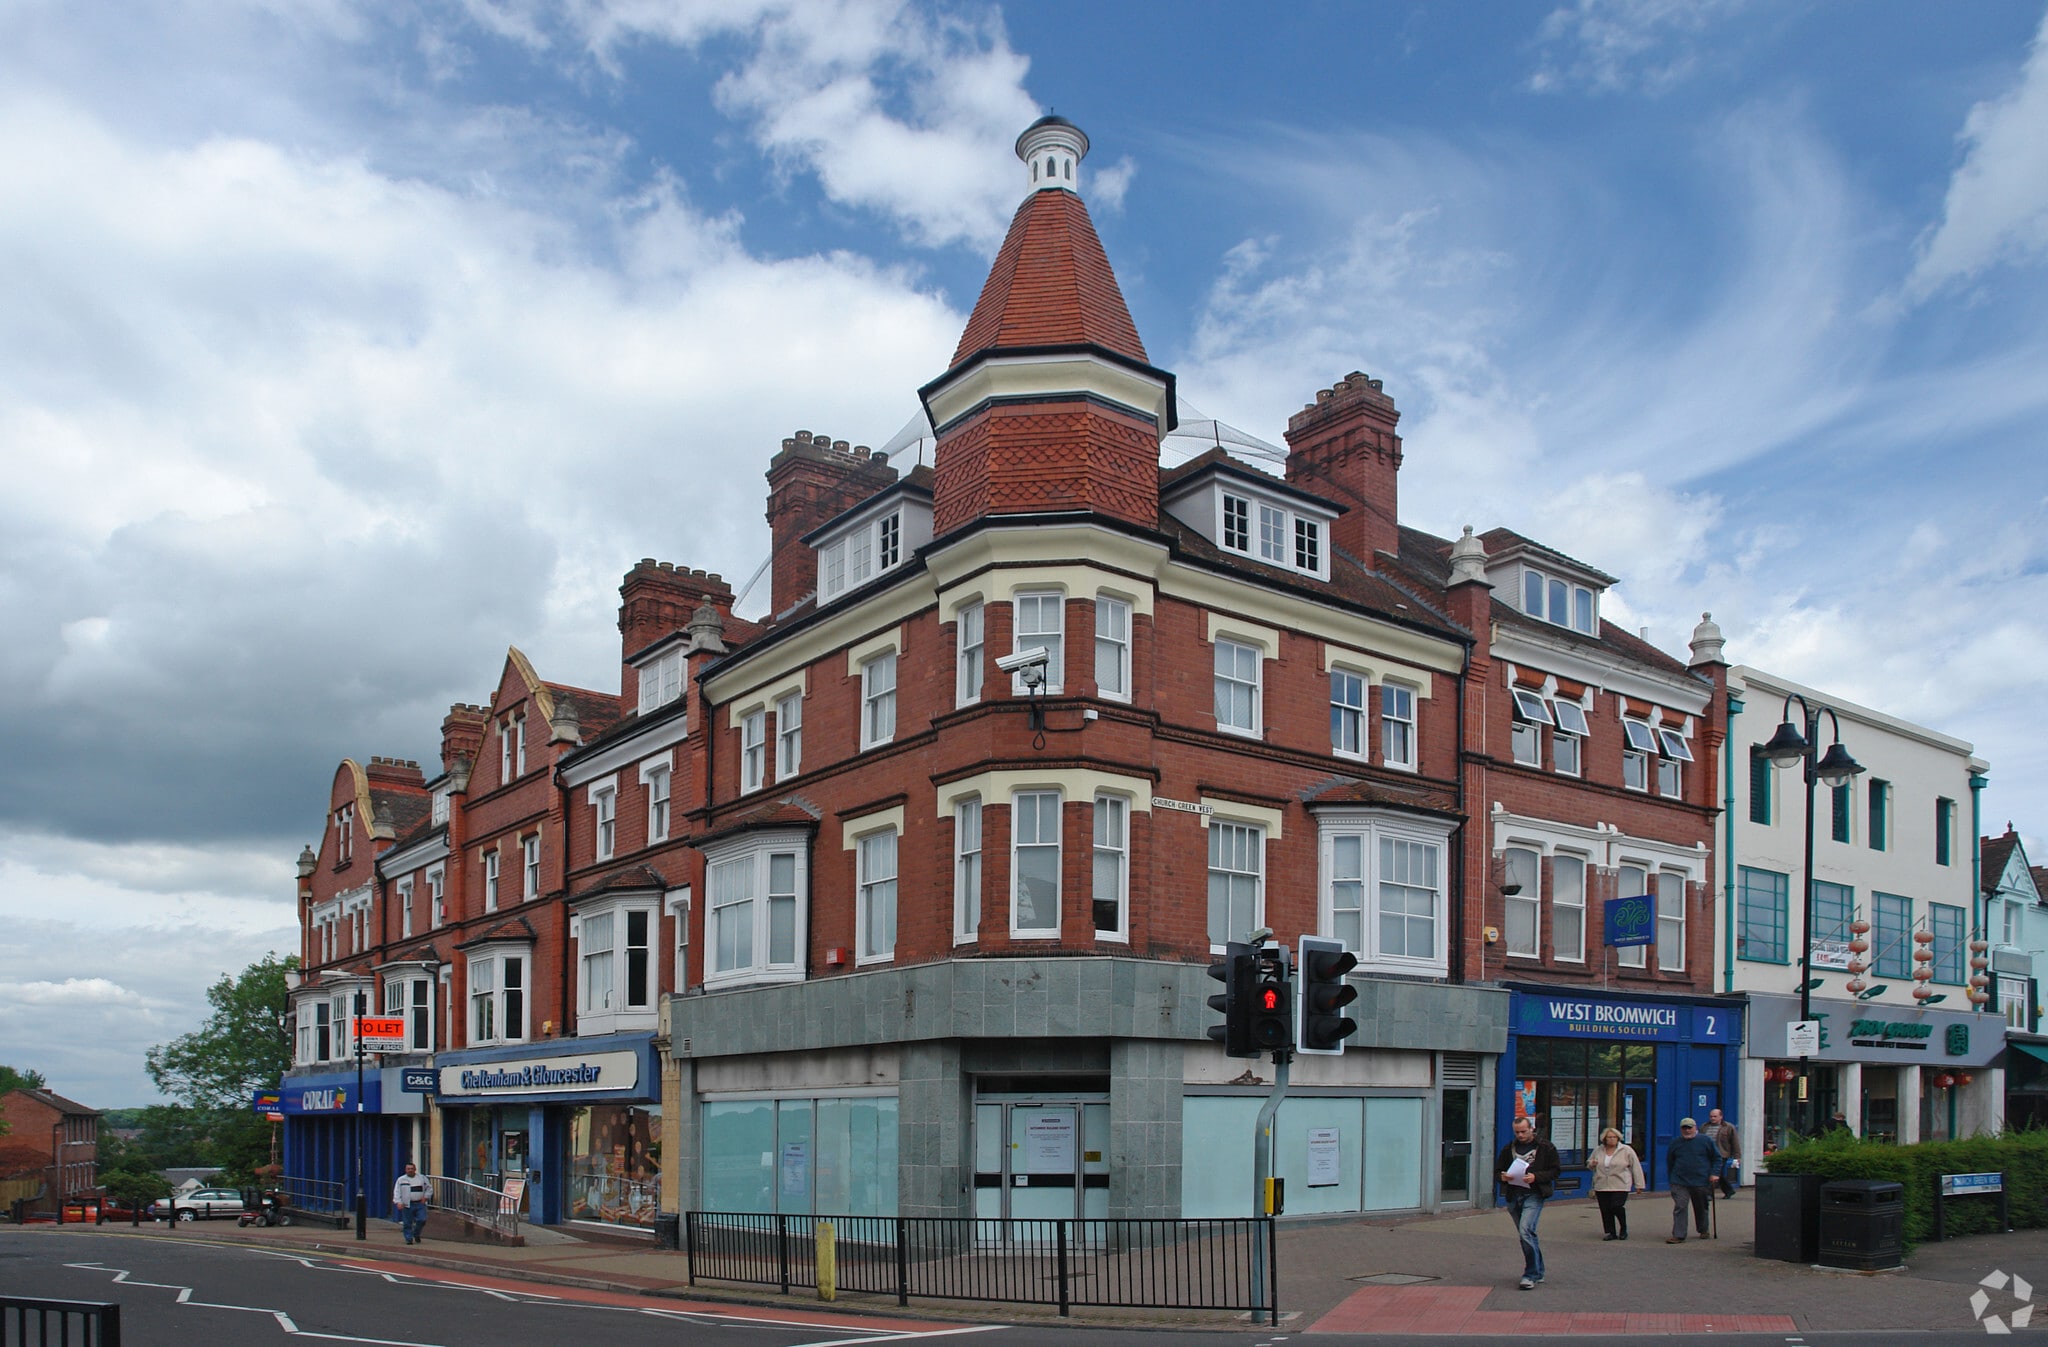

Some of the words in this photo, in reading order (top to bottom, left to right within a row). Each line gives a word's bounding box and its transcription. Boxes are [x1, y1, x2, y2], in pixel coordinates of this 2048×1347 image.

[1153, 798, 1176, 808] CHURCH
[1178, 802, 1196, 811] GREEN
[1198, 805, 1213, 814] WEST
[1549, 1001, 1592, 1021] WEST
[1595, 1005, 1676, 1026] BROMWICH
[355, 1023, 373, 1033] O
[377, 1023, 402, 1033] LET
[1569, 1023, 1615, 1034] BUILDING
[1617, 1026, 1658, 1035] SOCIETY
[1706, 1015, 1716, 1035] 2
[407, 1075, 433, 1086] C&G
[460, 1068, 520, 1089] Cheltenham
[520, 1066, 530, 1086] &
[531, 1063, 601, 1086] Gloucester
[302, 1089, 336, 1110] CORAL
